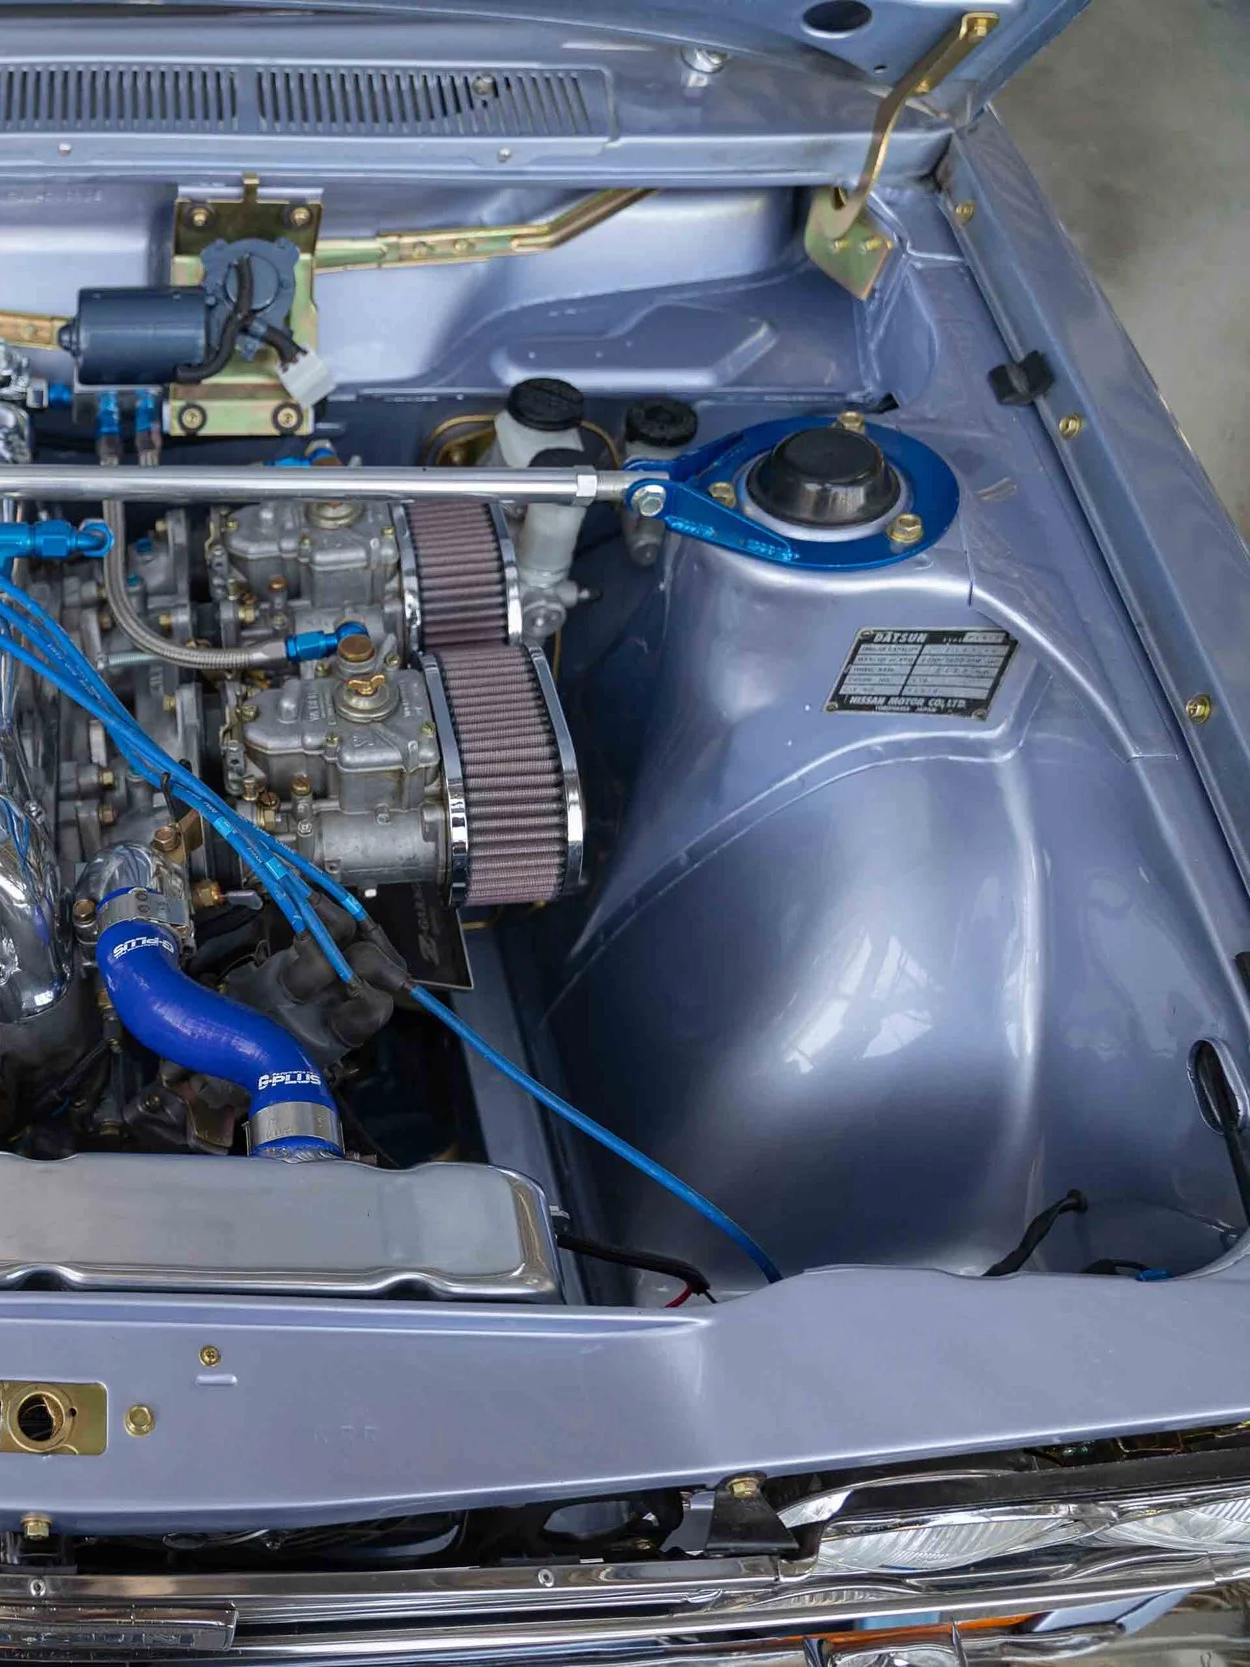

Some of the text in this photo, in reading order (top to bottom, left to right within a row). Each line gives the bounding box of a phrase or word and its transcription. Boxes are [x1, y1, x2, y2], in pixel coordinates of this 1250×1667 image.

[873, 633, 928, 643] DATSUN
[849, 696, 886, 705] NISSAN
[888, 697, 926, 706] MOTOR
[112, 936, 174, 956] G-PLUS
[258, 1073, 322, 1090] G-PLUS
